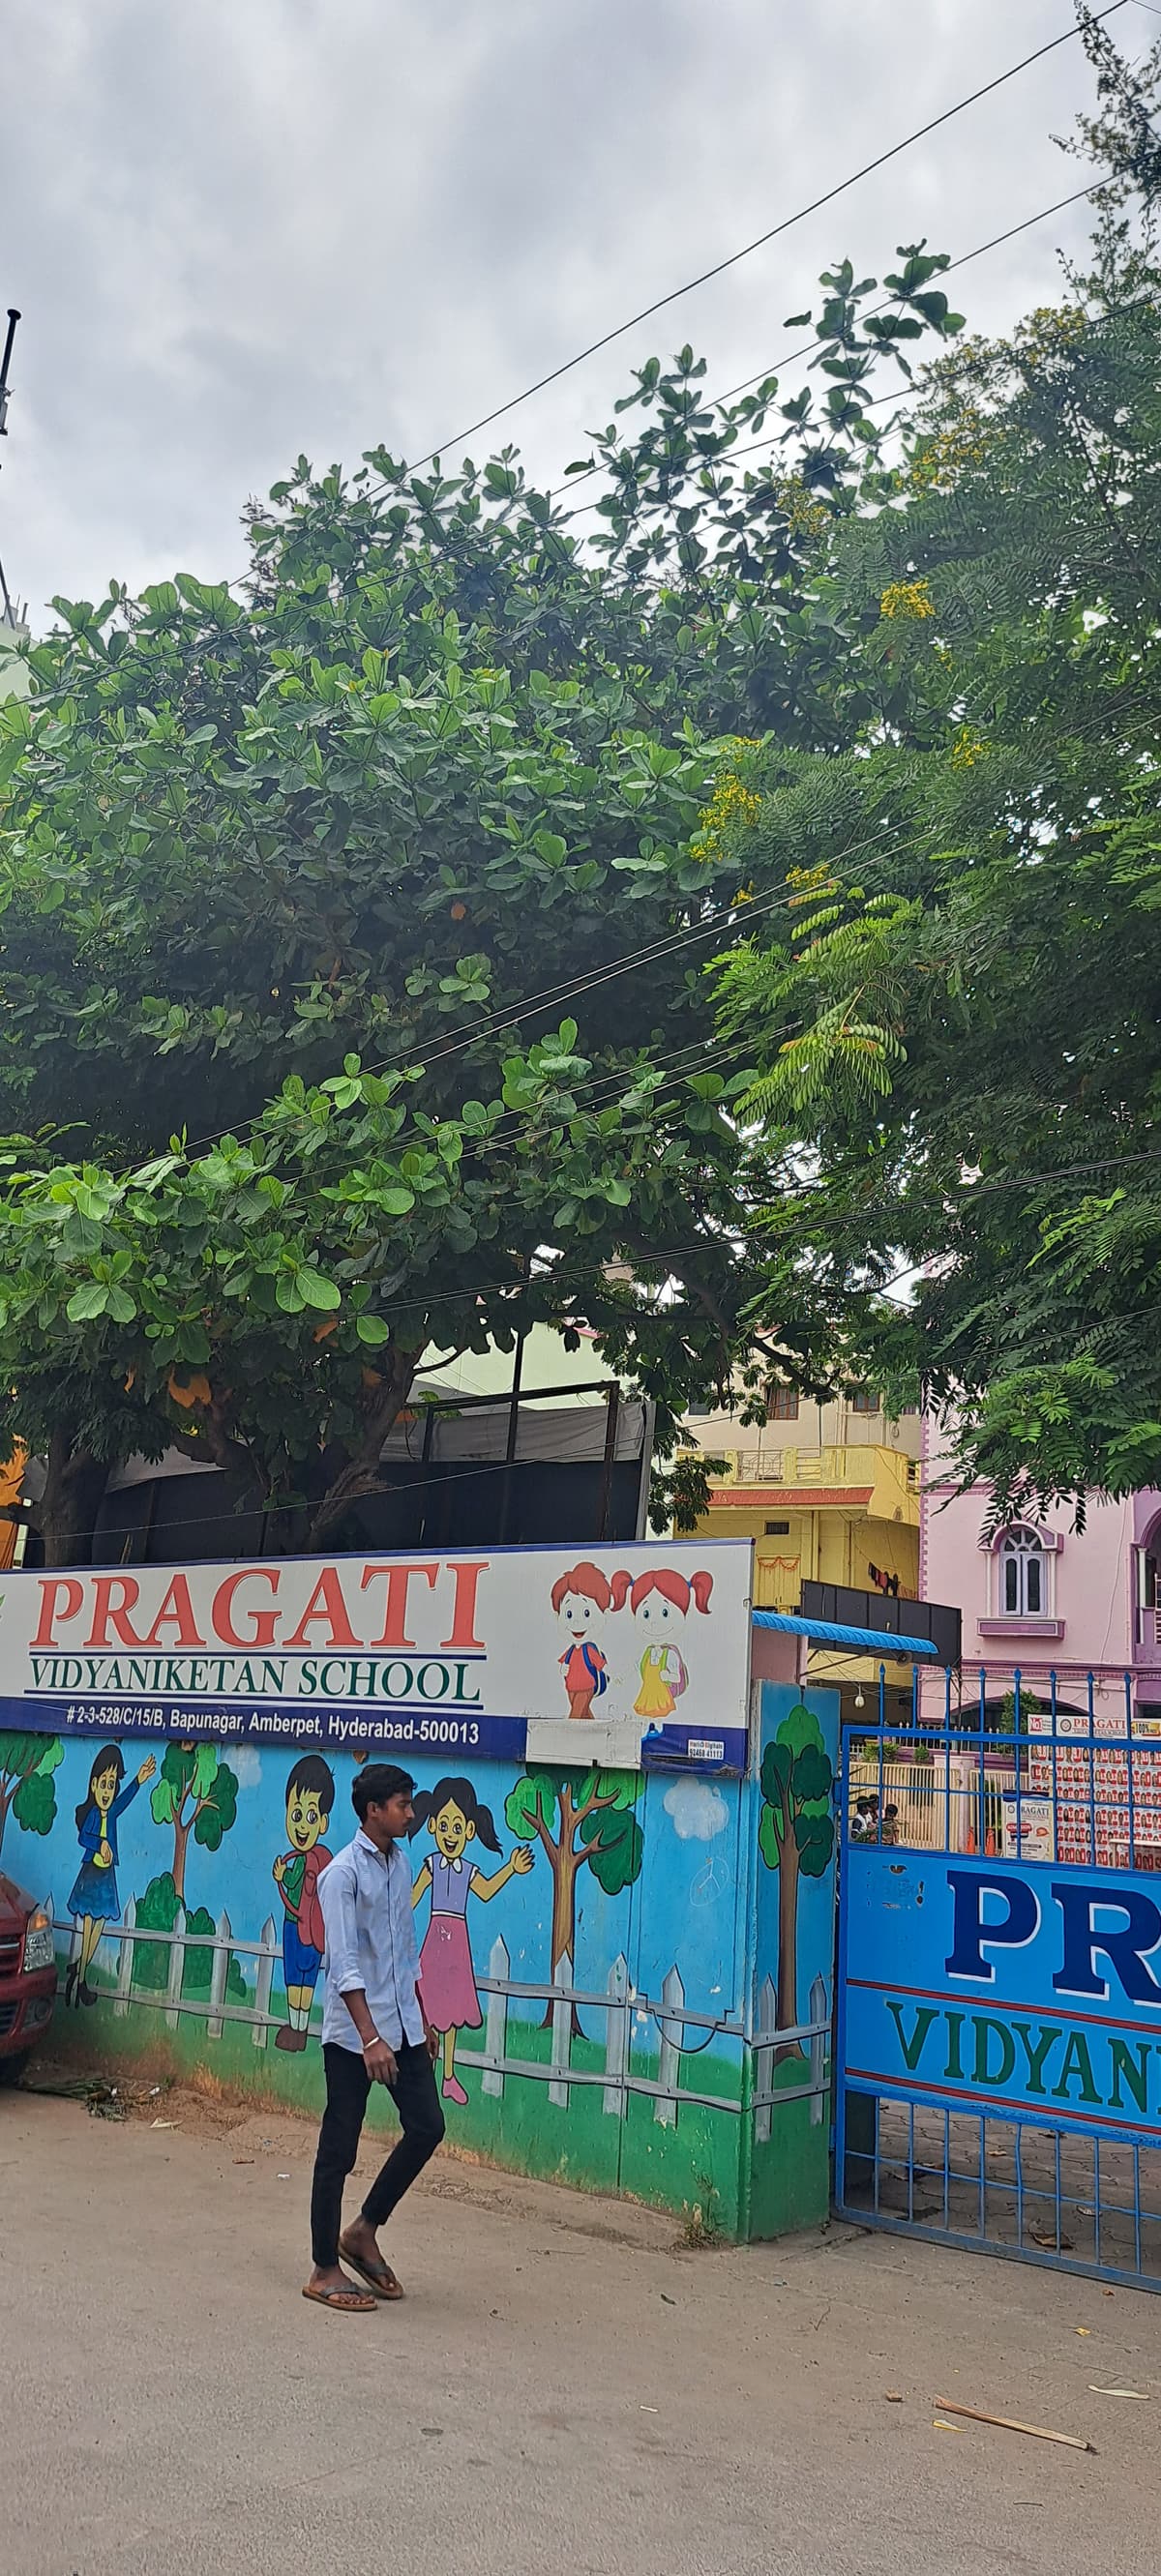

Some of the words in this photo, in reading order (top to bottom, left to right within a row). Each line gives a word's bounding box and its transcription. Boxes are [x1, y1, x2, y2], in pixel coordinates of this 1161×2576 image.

[29, 1561, 490, 1649] PRAGATI
[30, 1658, 287, 1694] VIDYANIKETAN
[298, 1659, 482, 1701] SCHOOL
[170, 1709, 245, 1733] Bapunagar,
[249, 1711, 323, 1737] Amberpet,
[328, 1715, 480, 1744] Hyderabad-500013
[944, 1870, 1161, 2009] PR
[885, 2000, 1161, 2116] VIDYAN
